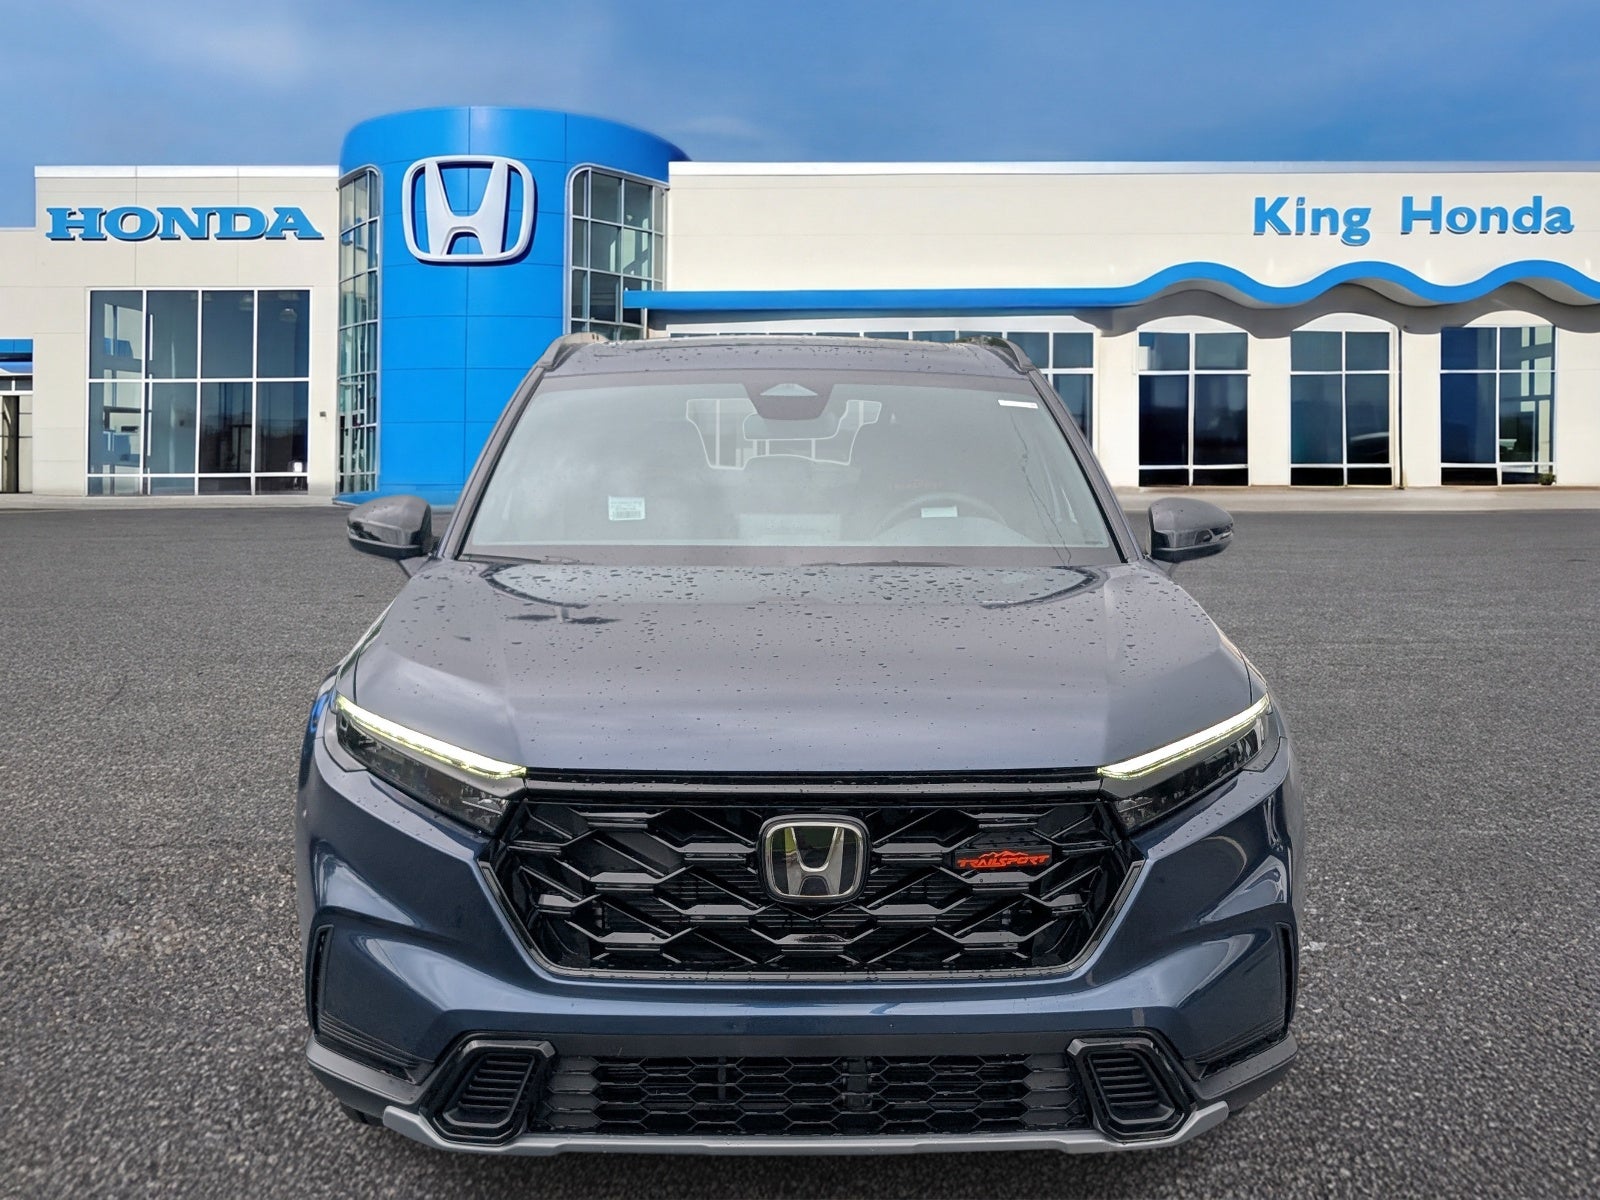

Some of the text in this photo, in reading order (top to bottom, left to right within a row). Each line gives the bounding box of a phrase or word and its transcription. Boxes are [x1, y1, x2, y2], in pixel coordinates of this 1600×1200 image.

[45, 206, 325, 241] HONDA
[1253, 195, 1575, 246] King Honda
[957, 854, 1050, 869] TRAILSPORT
